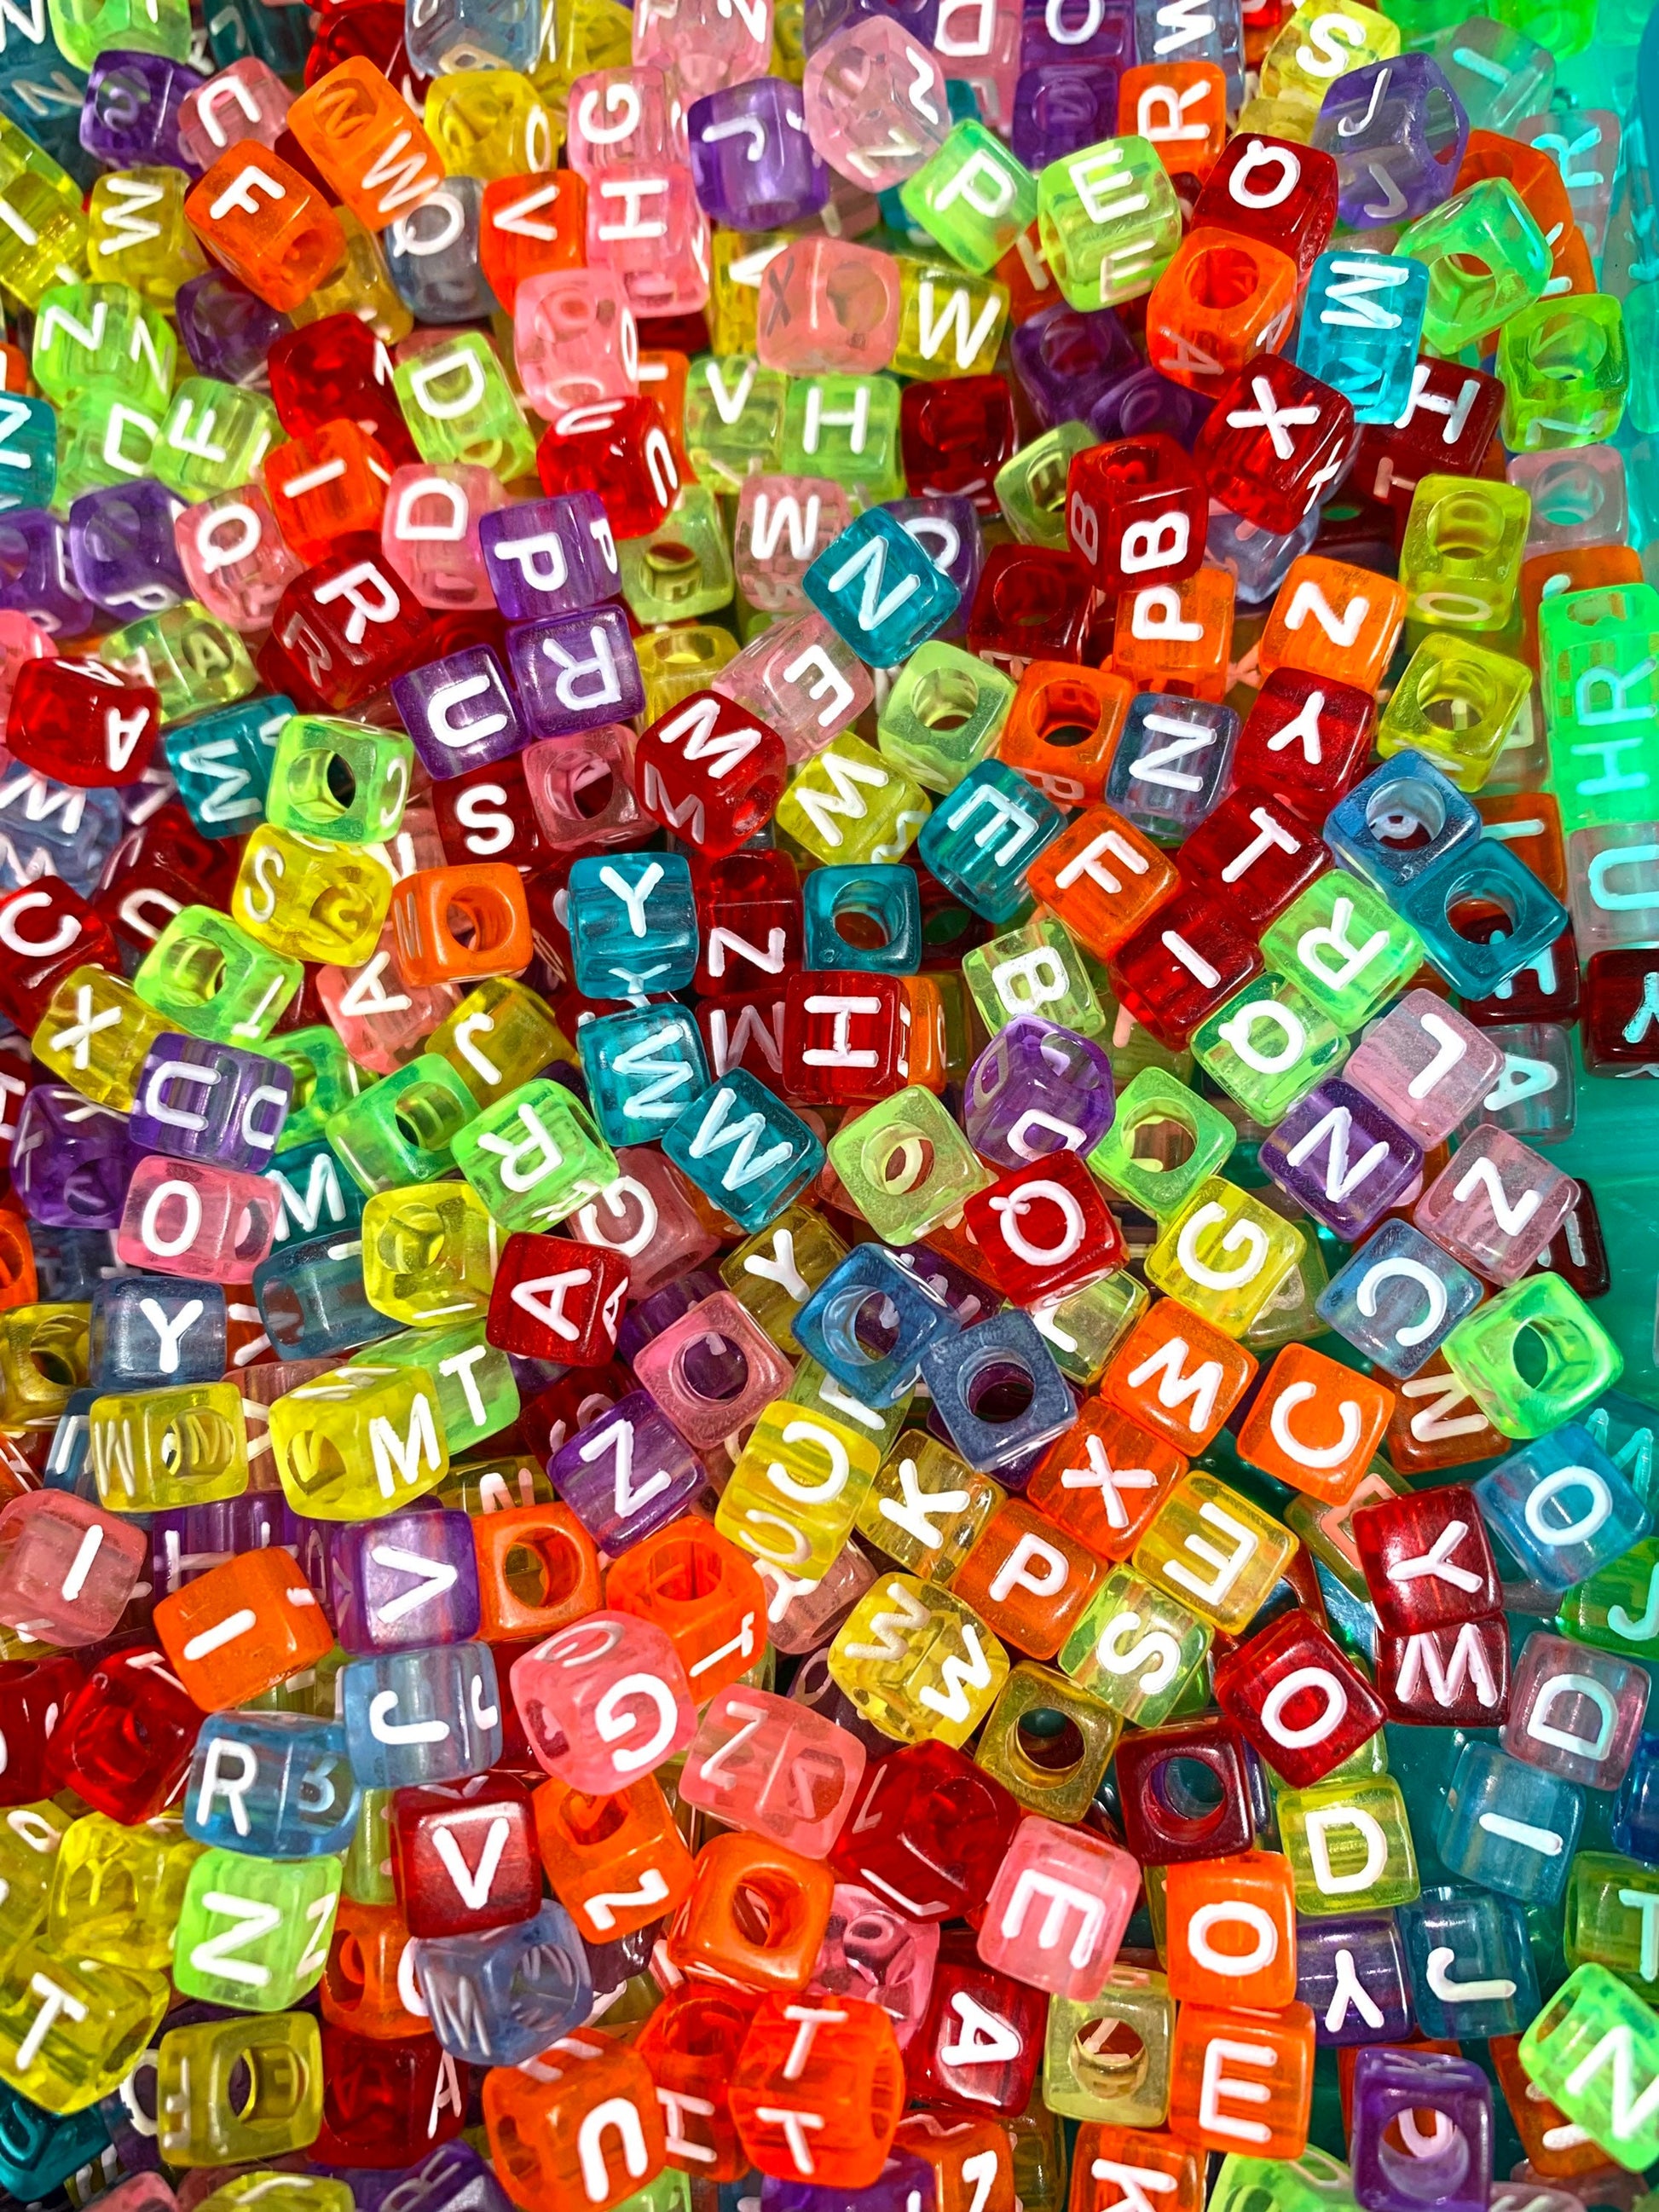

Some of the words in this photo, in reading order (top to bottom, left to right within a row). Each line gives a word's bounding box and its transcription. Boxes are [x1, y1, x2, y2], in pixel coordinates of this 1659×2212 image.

[1296, 13, 1367, 78] S
[579, 84, 641, 145] G
[702, 113, 766, 162] J
[1137, 80, 1211, 141] R
[1338, 67, 1392, 137] J
[210, 165, 286, 220] F
[934, 149, 1017, 217] P
[1069, 148, 1150, 224] E
[1228, 139, 1301, 209] Q
[393, 192, 465, 257] Q
[918, 281, 1002, 370] W
[410, 348, 486, 419] D
[706, 361, 757, 424] V
[802, 386, 870, 455] H
[1226, 376, 1321, 460] X
[168, 398, 227, 463] F
[283, 459, 347, 498] I
[395, 477, 469, 540] D
[196, 504, 263, 574] Q
[494, 531, 569, 592] P
[1120, 511, 1190, 575] B
[314, 561, 401, 644] R
[1132, 586, 1203, 643] P
[282, 611, 333, 687] R
[542, 626, 622, 712] R
[783, 644, 856, 727] E
[428, 674, 508, 748] U
[1268, 691, 1325, 764] Y
[1575, 658, 1659, 726] R
[104, 706, 150, 771] A
[1570, 737, 1651, 796] H
[456, 783, 514, 856] S
[947, 784, 1039, 867] E
[1222, 806, 1301, 883] T
[244, 844, 286, 924] S
[1055, 829, 1149, 894] F
[0, 892, 82, 956] C
[599, 863, 664, 938] Y
[992, 944, 1071, 1016] B
[1161, 930, 1221, 988] I
[1296, 898, 1390, 990] R
[341, 950, 413, 1017] A
[51, 984, 123, 1070] X
[454, 1012, 502, 1086] J
[1219, 999, 1308, 1074] Q
[1408, 1013, 1467, 1100] L
[477, 1103, 564, 1193] R
[142, 1179, 203, 1256] O
[578, 1175, 659, 1259] G
[989, 1180, 1085, 1267] Q
[1176, 1201, 1269, 1291] G
[743, 1228, 811, 1302] Y
[1356, 1257, 1448, 1348] C
[139, 1297, 205, 1373] Y
[511, 1268, 592, 1342] A
[439, 1344, 488, 1426] T
[368, 1392, 442, 1499] M
[1269, 1381, 1361, 1468] C
[879, 1458, 970, 1549] K
[1061, 1434, 1158, 1529] X
[1525, 1465, 1614, 1546] O
[62, 1524, 104, 1602] I
[988, 1533, 1069, 1602] P
[1163, 1502, 1258, 1606] E
[1386, 1520, 1484, 1593] Y
[184, 1608, 257, 1661] I
[1098, 1611, 1182, 1695] S
[369, 1690, 451, 1746] J
[596, 1672, 679, 1772] G
[1262, 1666, 1348, 1750] O
[1527, 1673, 1618, 1761] D
[196, 1737, 258, 1837] R
[432, 1816, 511, 1909] V
[1305, 1806, 1388, 1895] D
[1478, 1812, 1565, 1857] I
[1001, 1869, 1107, 1970] E
[1188, 1901, 1278, 1977] O
[1324, 1949, 1385, 2033] Y
[1426, 1947, 1517, 2002] J
[15, 1971, 86, 2071] T
[783, 2005, 848, 2080] T
[941, 1991, 1021, 2066] A
[1198, 2037, 1279, 2142] E
[755, 2106, 825, 2174] T
